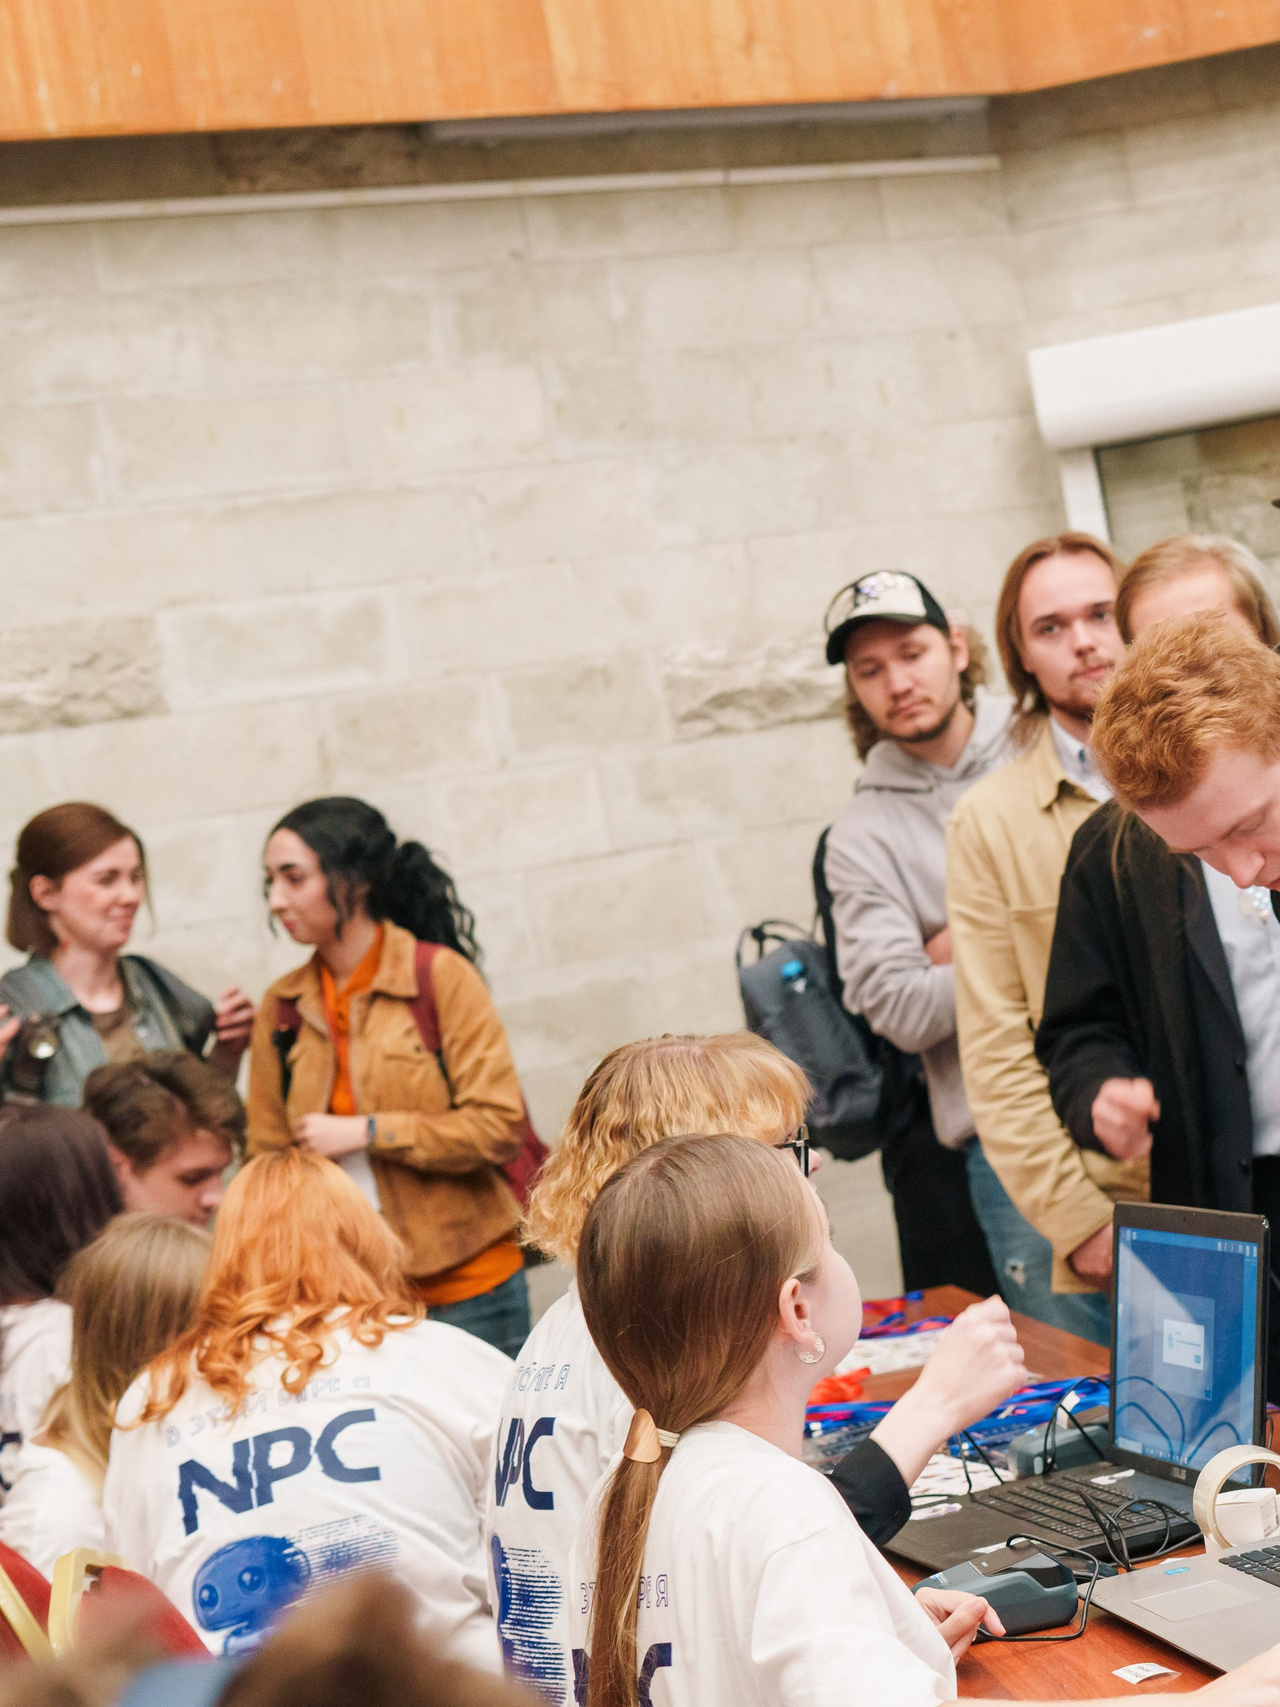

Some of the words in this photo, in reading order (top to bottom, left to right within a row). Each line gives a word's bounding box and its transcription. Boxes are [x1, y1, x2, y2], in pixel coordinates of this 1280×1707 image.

[554, 1364, 570, 1390] Я
[178, 1408, 381, 1536] NPC
[656, 1574, 669, 1607] Я
